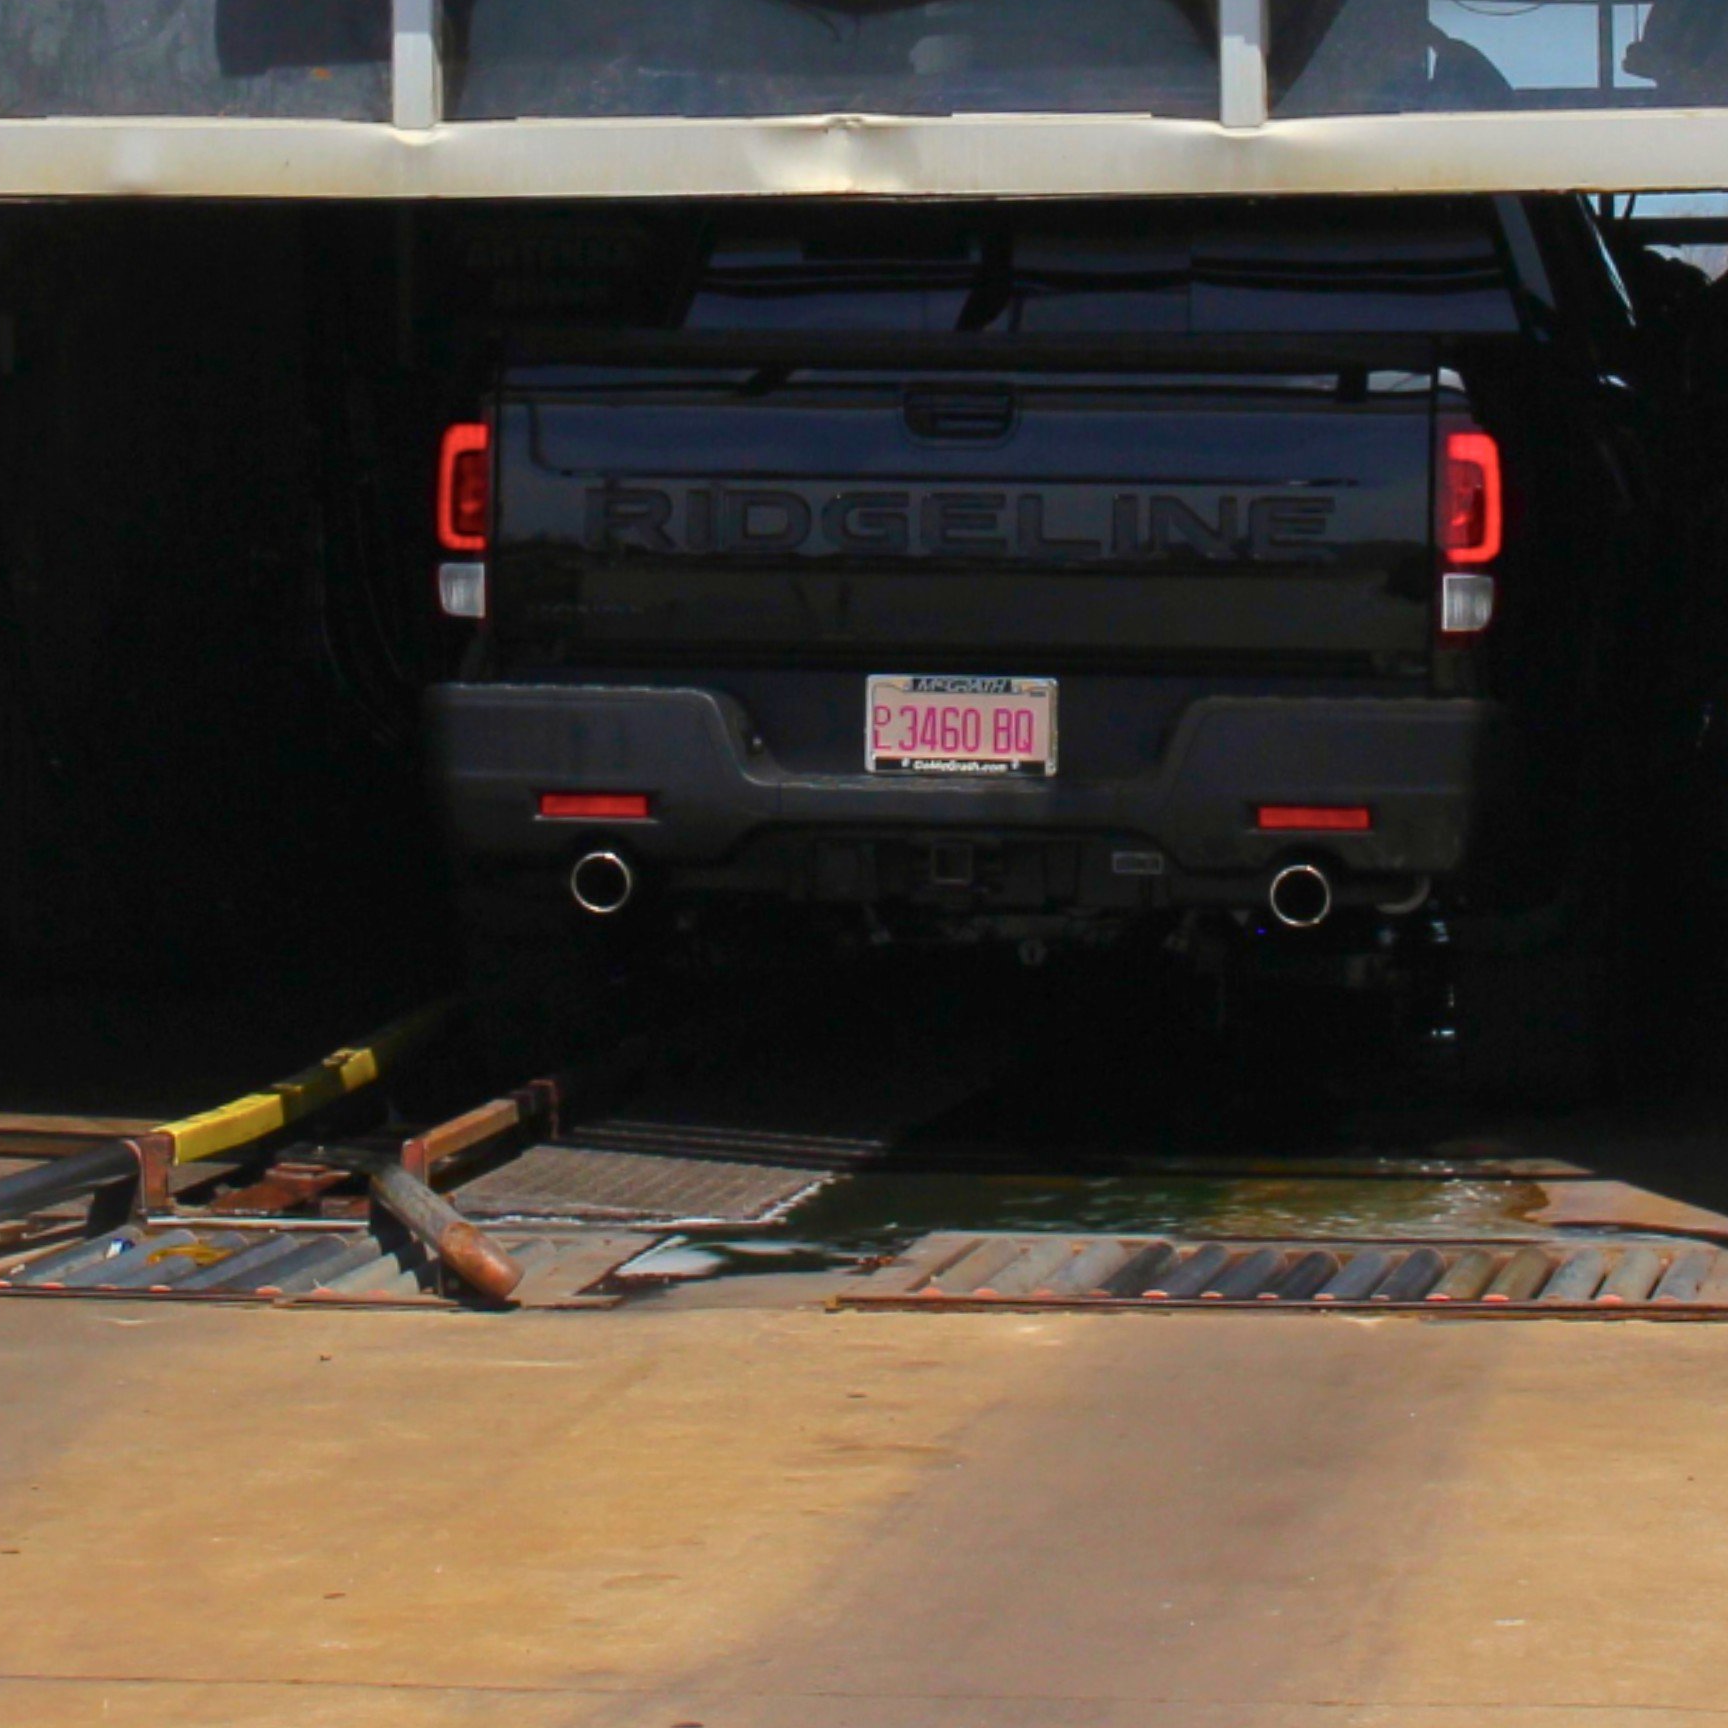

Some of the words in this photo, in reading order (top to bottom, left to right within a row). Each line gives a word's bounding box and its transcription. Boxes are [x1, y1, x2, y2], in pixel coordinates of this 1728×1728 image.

[582, 485, 1337, 560] RIDGELINE
[898, 705, 982, 753] 3460
[992, 707, 1034, 755] BQ
